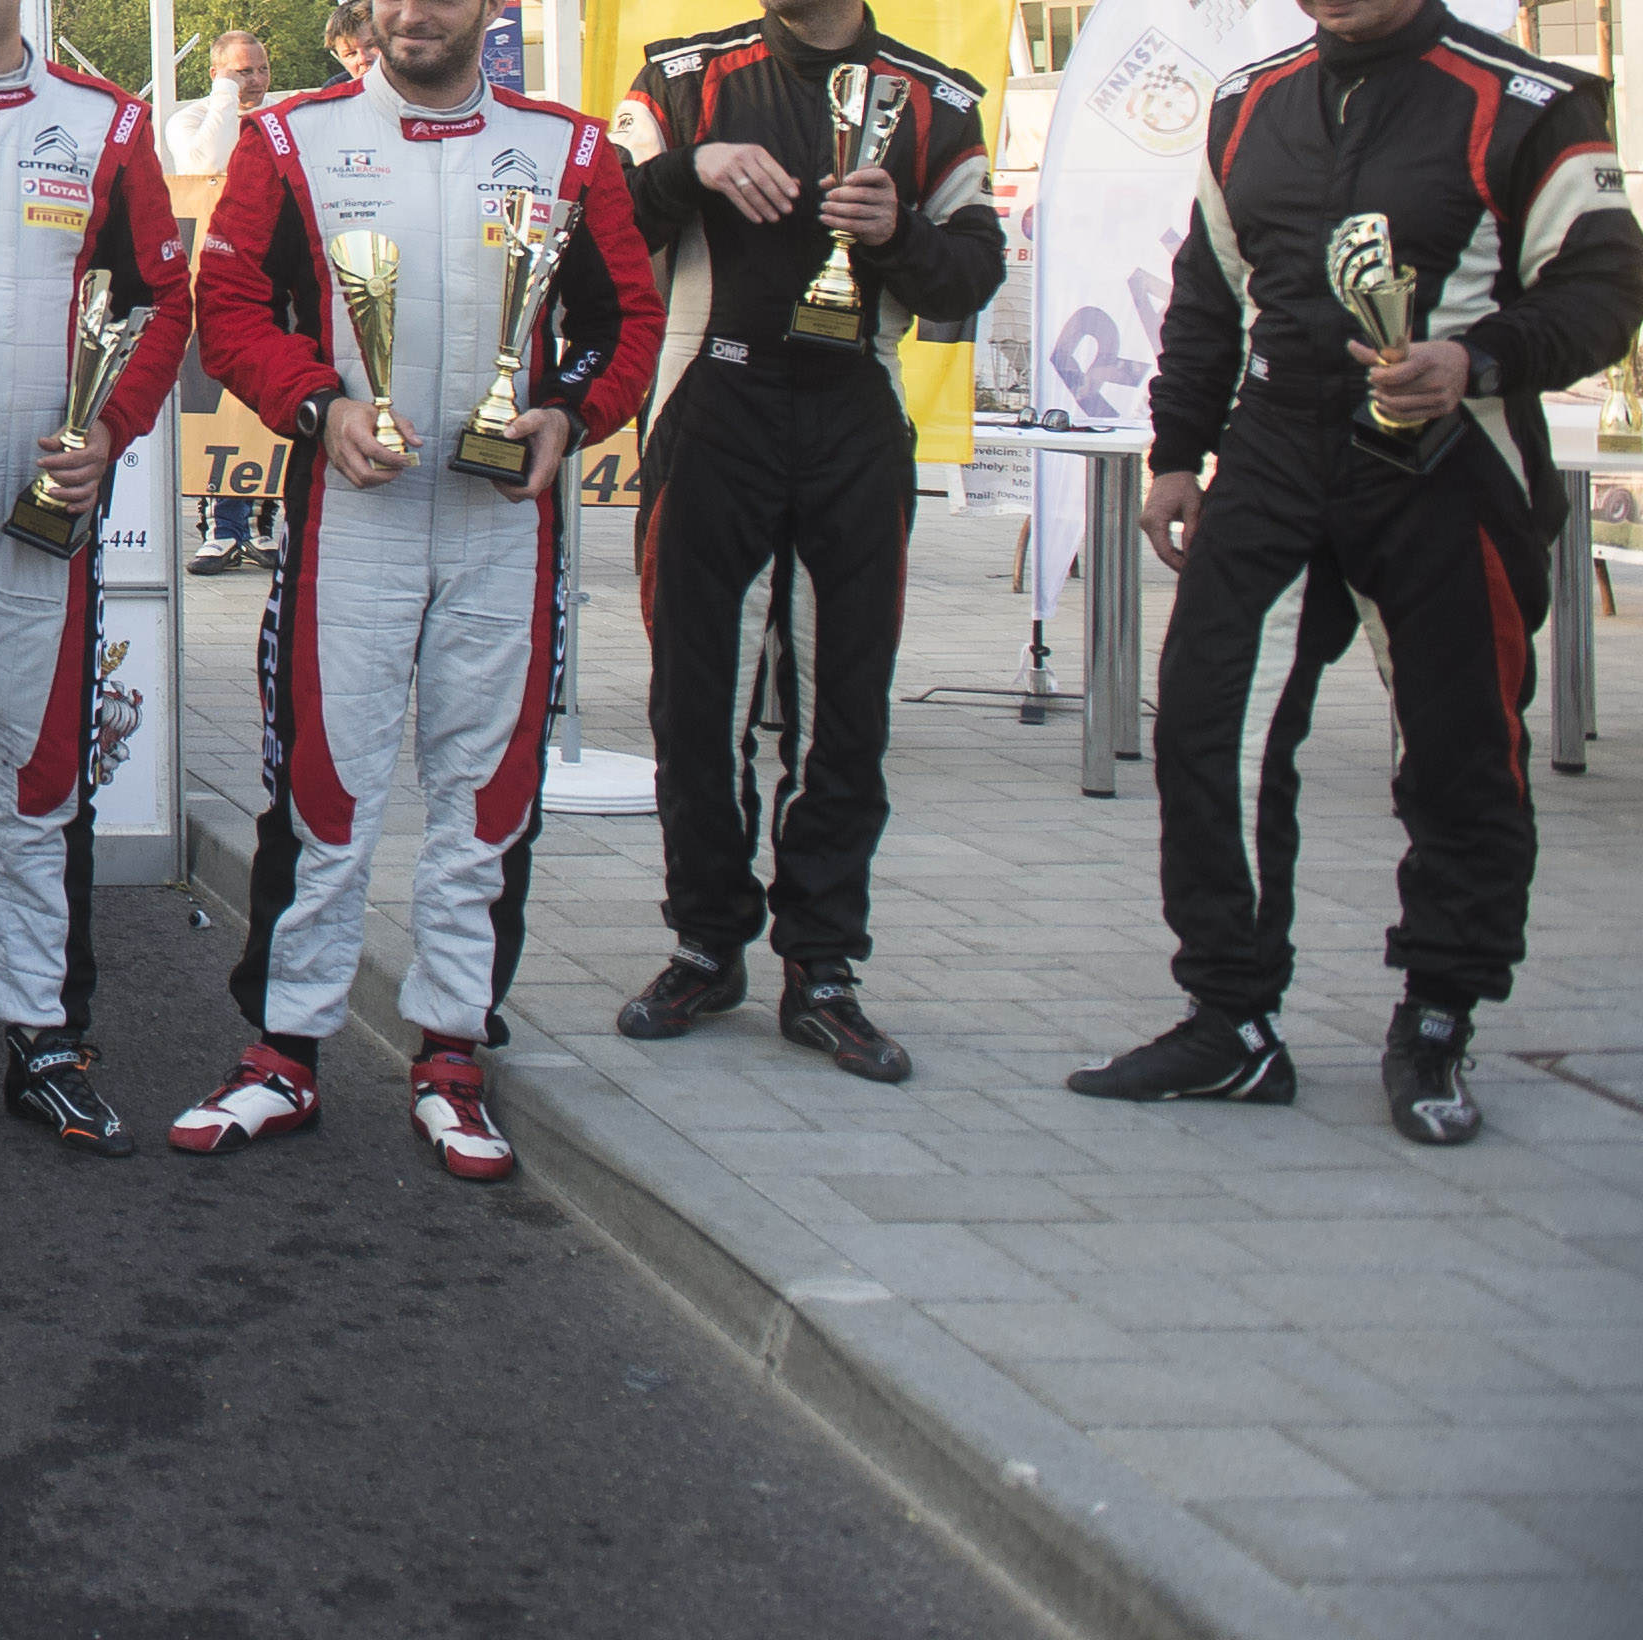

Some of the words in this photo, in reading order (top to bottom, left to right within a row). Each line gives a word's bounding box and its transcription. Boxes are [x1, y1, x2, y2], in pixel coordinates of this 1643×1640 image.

[663, 57, 703, 74] OMP
[1093, 32, 1166, 113] MNASZ
[934, 84, 971, 107] OMP
[1508, 79, 1554, 103] OMP
[112, 102, 141, 145] sparco
[261, 112, 292, 156] sparco
[574, 123, 600, 168] sparco
[40, 181, 88, 199] TOTAL
[27, 206, 85, 227] PIRELLI
[712, 343, 749, 361] OMP
